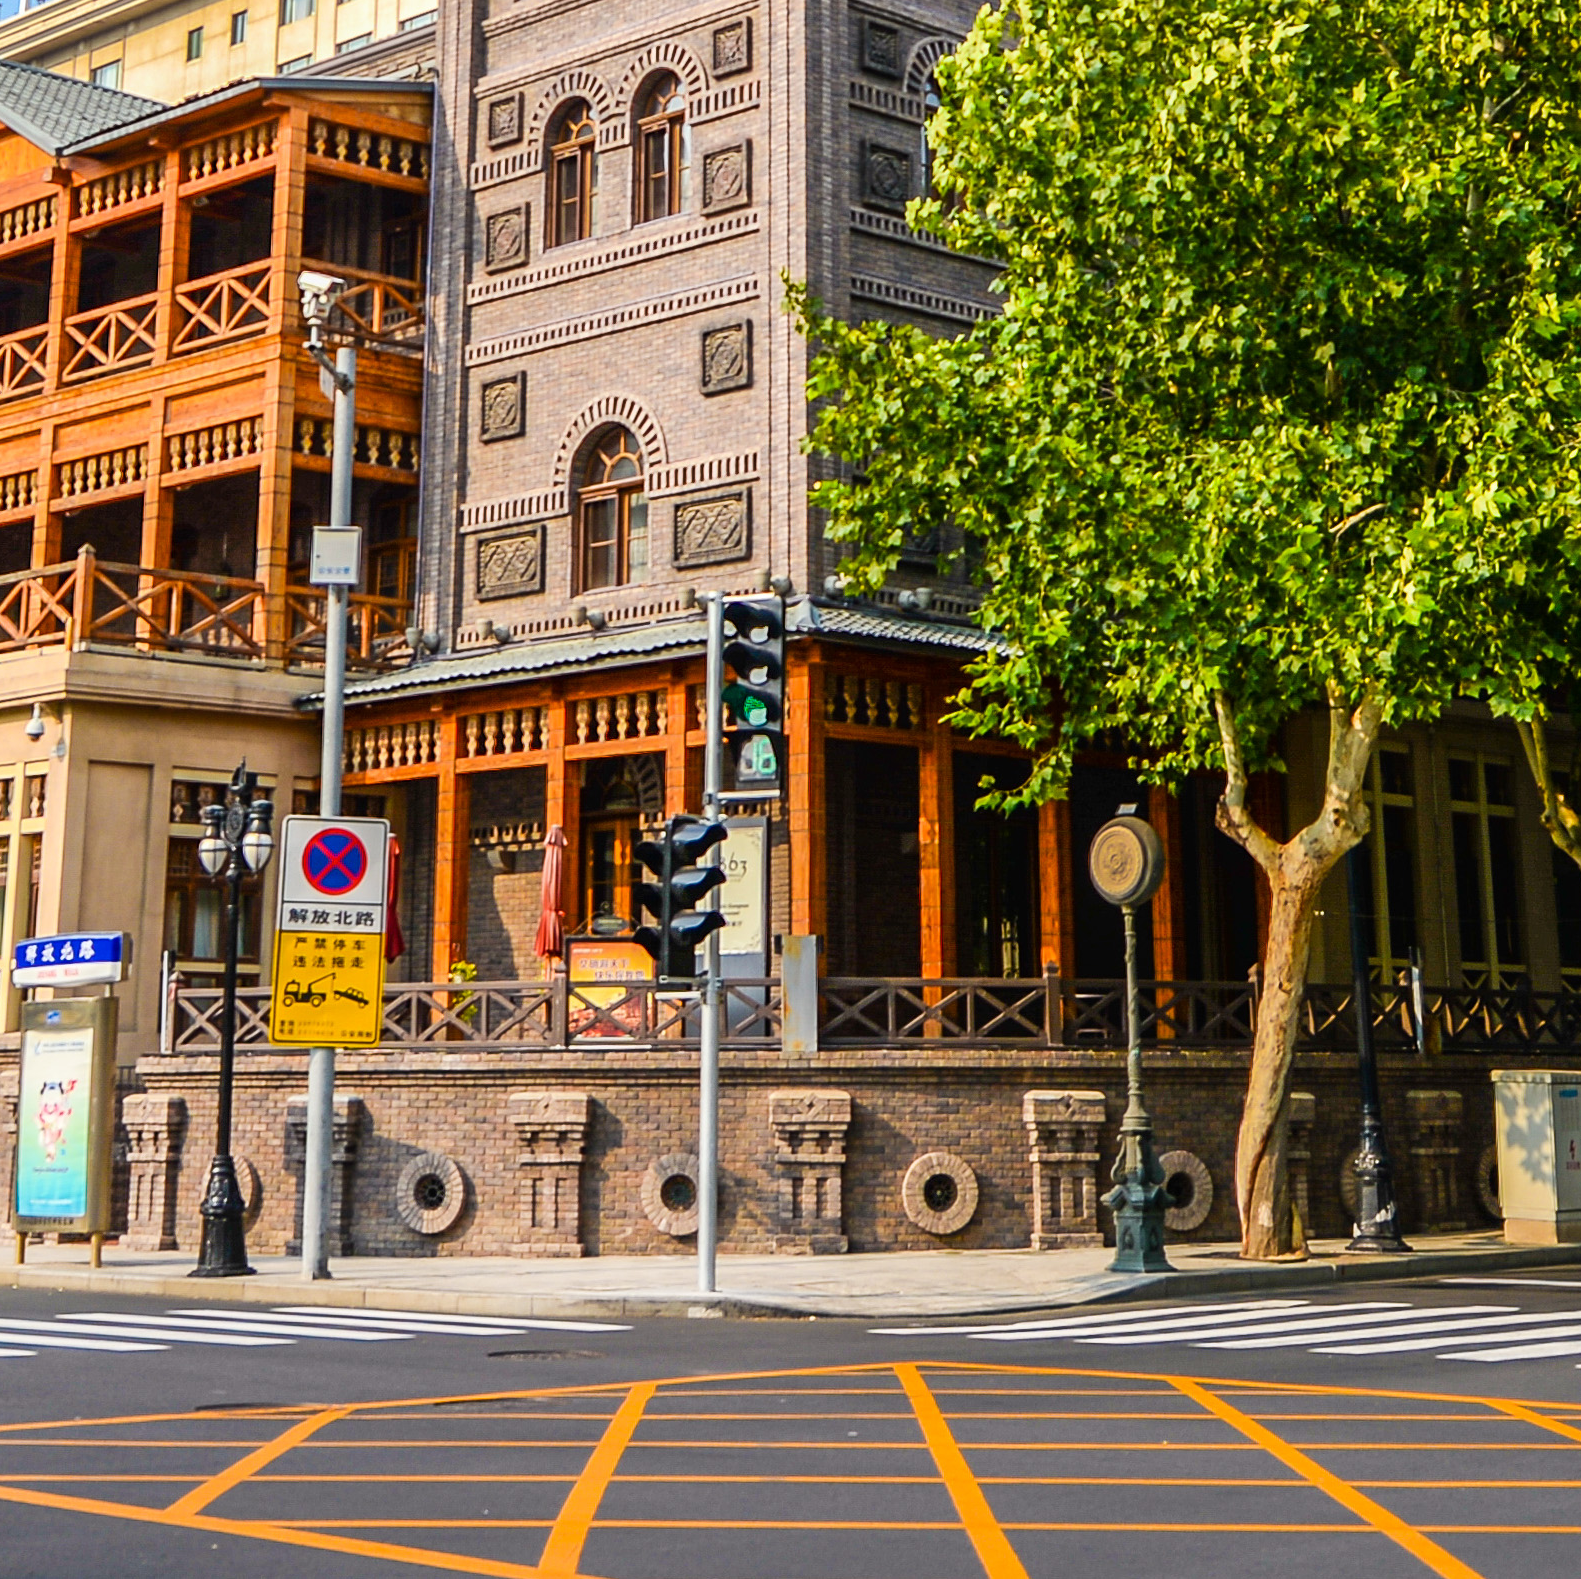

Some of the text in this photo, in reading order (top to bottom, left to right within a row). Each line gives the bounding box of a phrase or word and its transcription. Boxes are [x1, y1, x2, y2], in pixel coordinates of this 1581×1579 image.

[288, 908, 375, 927] 解放北路
[294, 936, 366, 951] 严禁停车
[292, 955, 364, 969] 违法拖走
